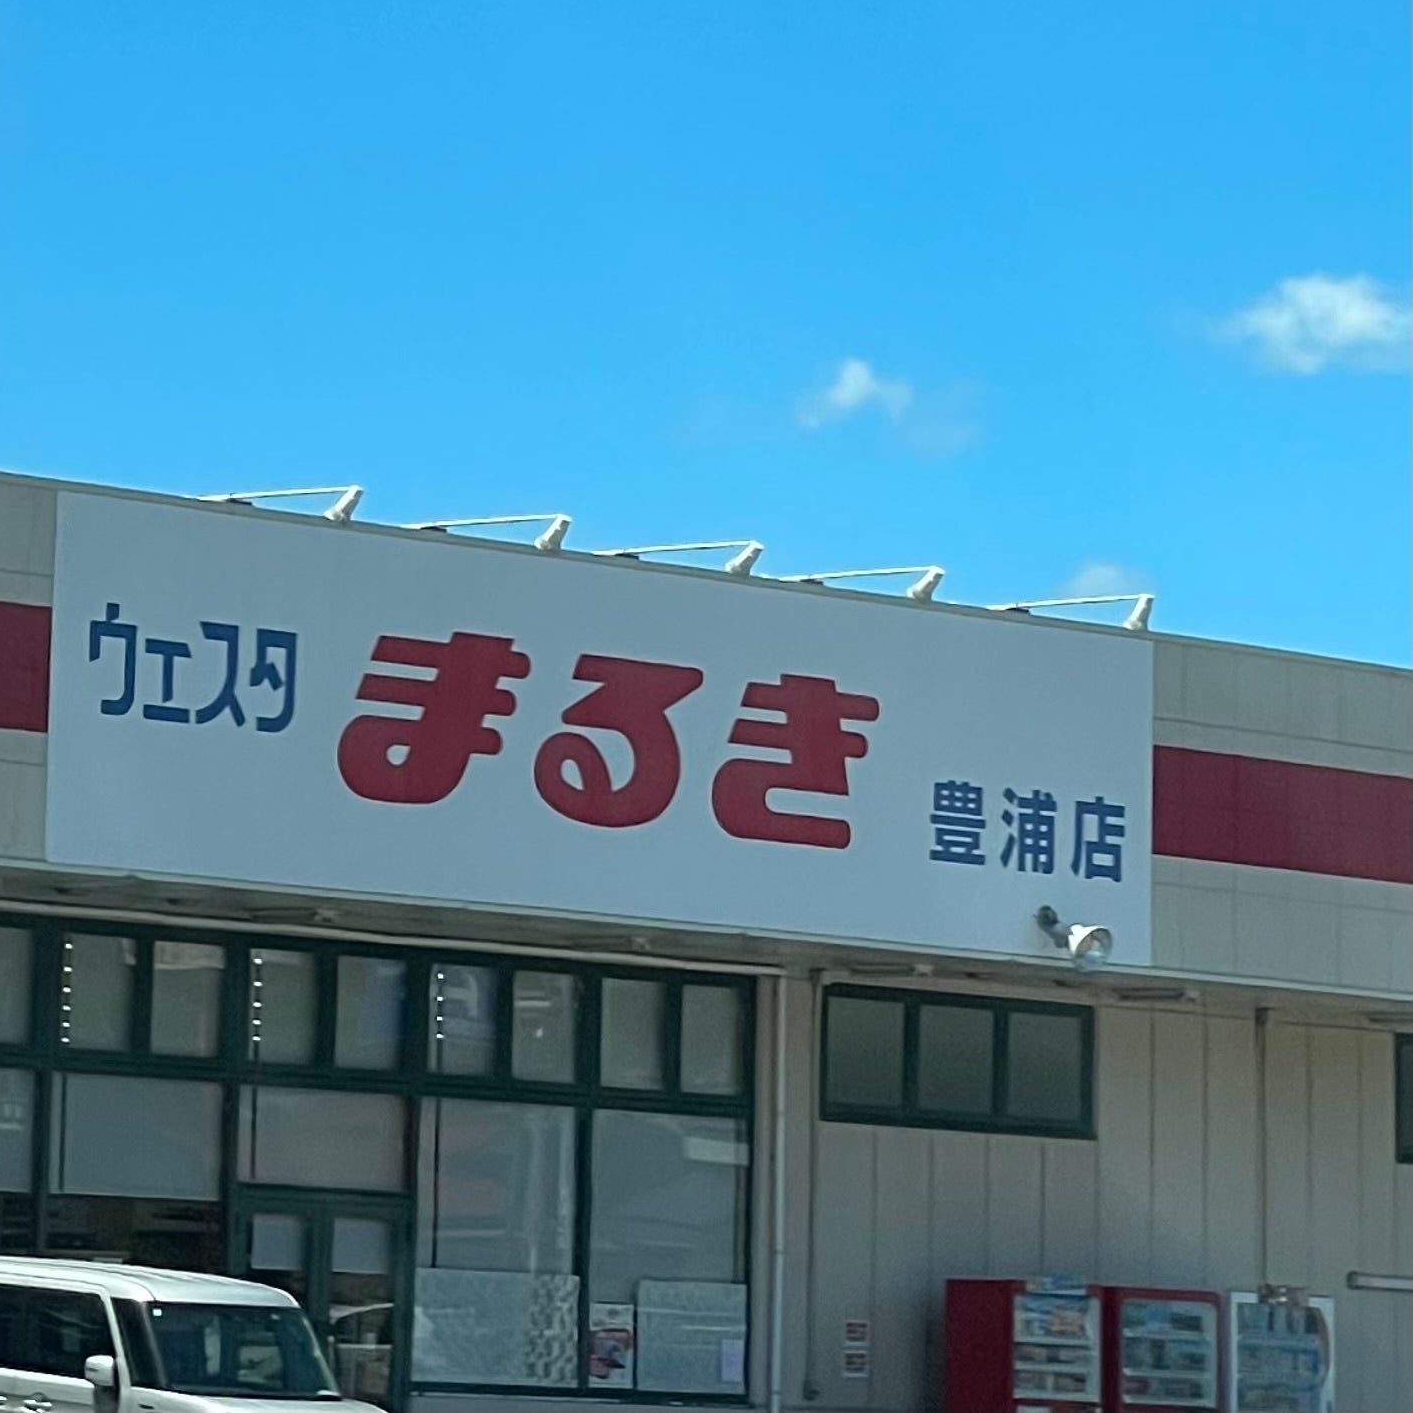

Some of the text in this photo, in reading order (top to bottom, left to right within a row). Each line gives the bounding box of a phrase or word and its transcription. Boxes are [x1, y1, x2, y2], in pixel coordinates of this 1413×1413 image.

[337, 631, 881, 851] まるき
[929, 779, 1127, 884] 豊浦店
